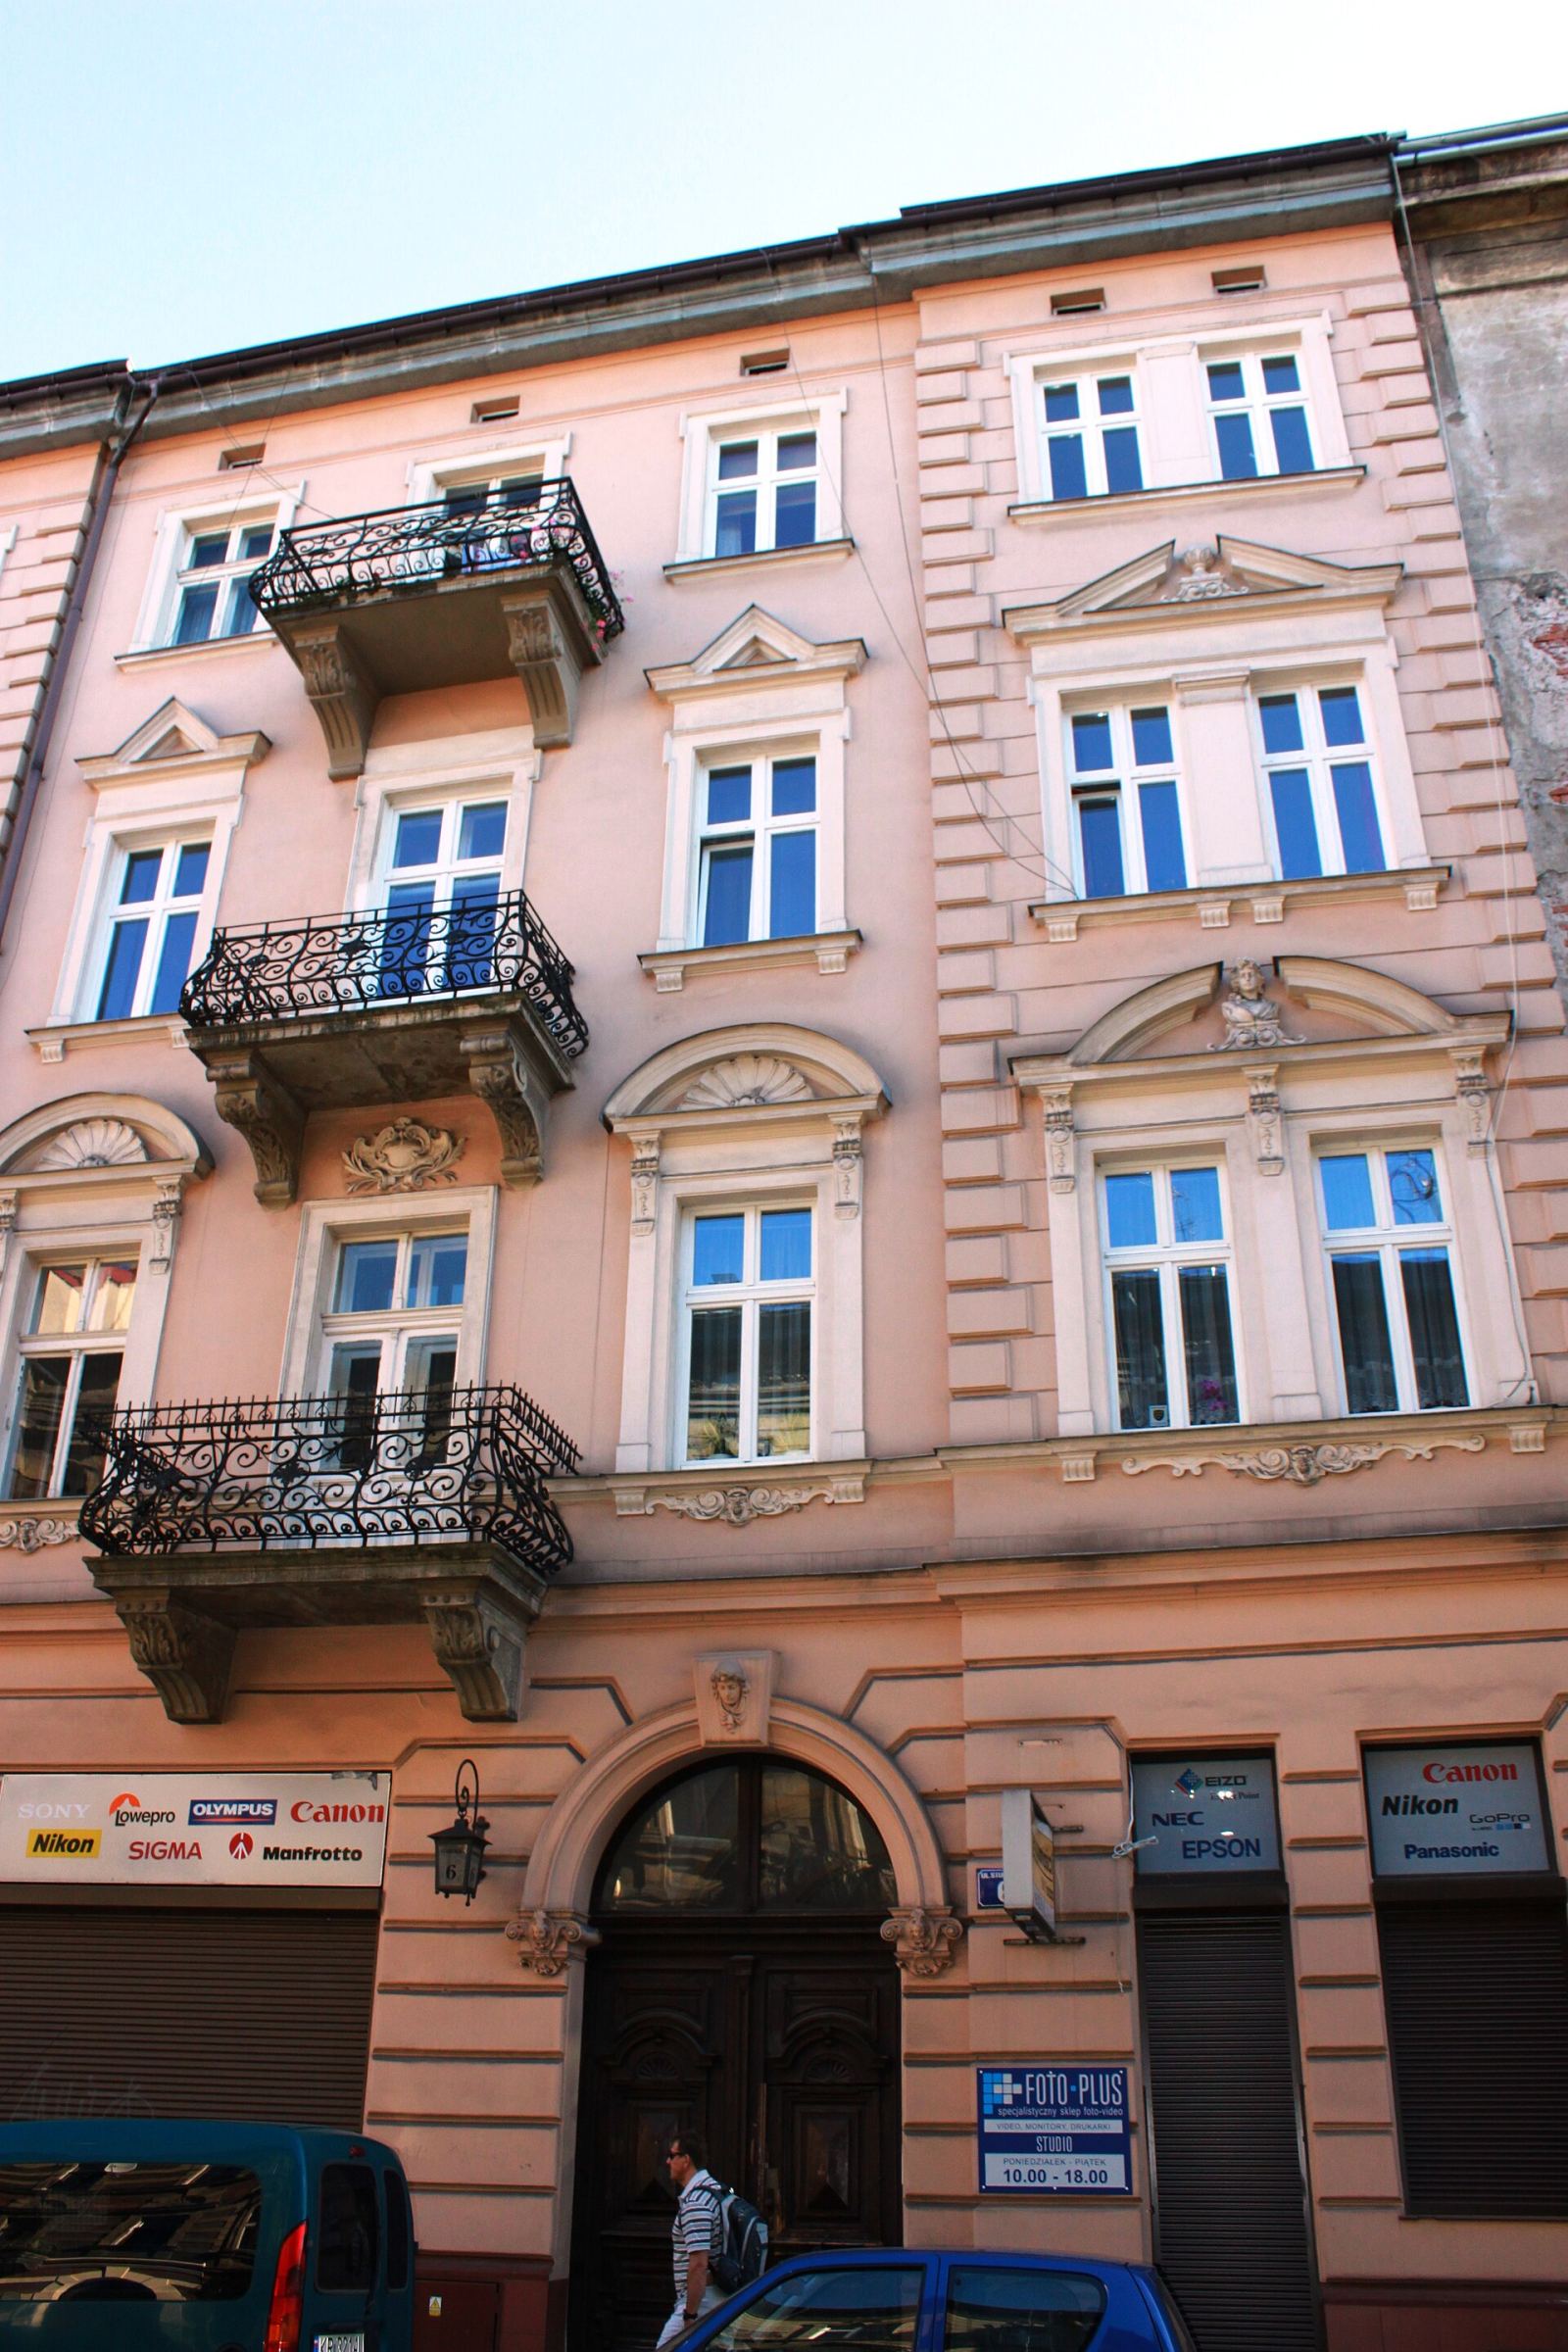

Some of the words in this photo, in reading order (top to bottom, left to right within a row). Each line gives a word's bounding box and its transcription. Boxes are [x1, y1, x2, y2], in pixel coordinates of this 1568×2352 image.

[1204, 1775, 1247, 1787] EIZO
[1422, 1763, 1518, 1784] Canon
[17, 1803, 90, 1819] SONY
[193, 1803, 274, 1817] OLYMPUS
[290, 1801, 384, 1823] Canon
[1382, 1795, 1459, 1816] Nikon
[115, 1808, 175, 1827] Lowepro
[1152, 1811, 1204, 1827] NEC
[1470, 1813, 1530, 1823] GoPro
[32, 1834, 94, 1853] Nikon
[128, 1841, 203, 1860] SIGMA
[1182, 1838, 1261, 1859] EPSON
[1403, 1841, 1500, 1859] Panasonic
[263, 1845, 363, 1862] Manfrotto
[446, 1864, 457, 1880] 6
[1025, 2073, 1067, 2105] FOTO
[1079, 2074, 1122, 2105] PLUS
[998, 2107, 1056, 2117] specjalistyczny
[1060, 2107, 1081, 2117] sklep
[1084, 2107, 1123, 2116] foto-video
[1036, 2135, 1073, 2152] STUDIO
[1004, 2169, 1047, 2183] 10.00
[1064, 2170, 1108, 2183] 18.00
